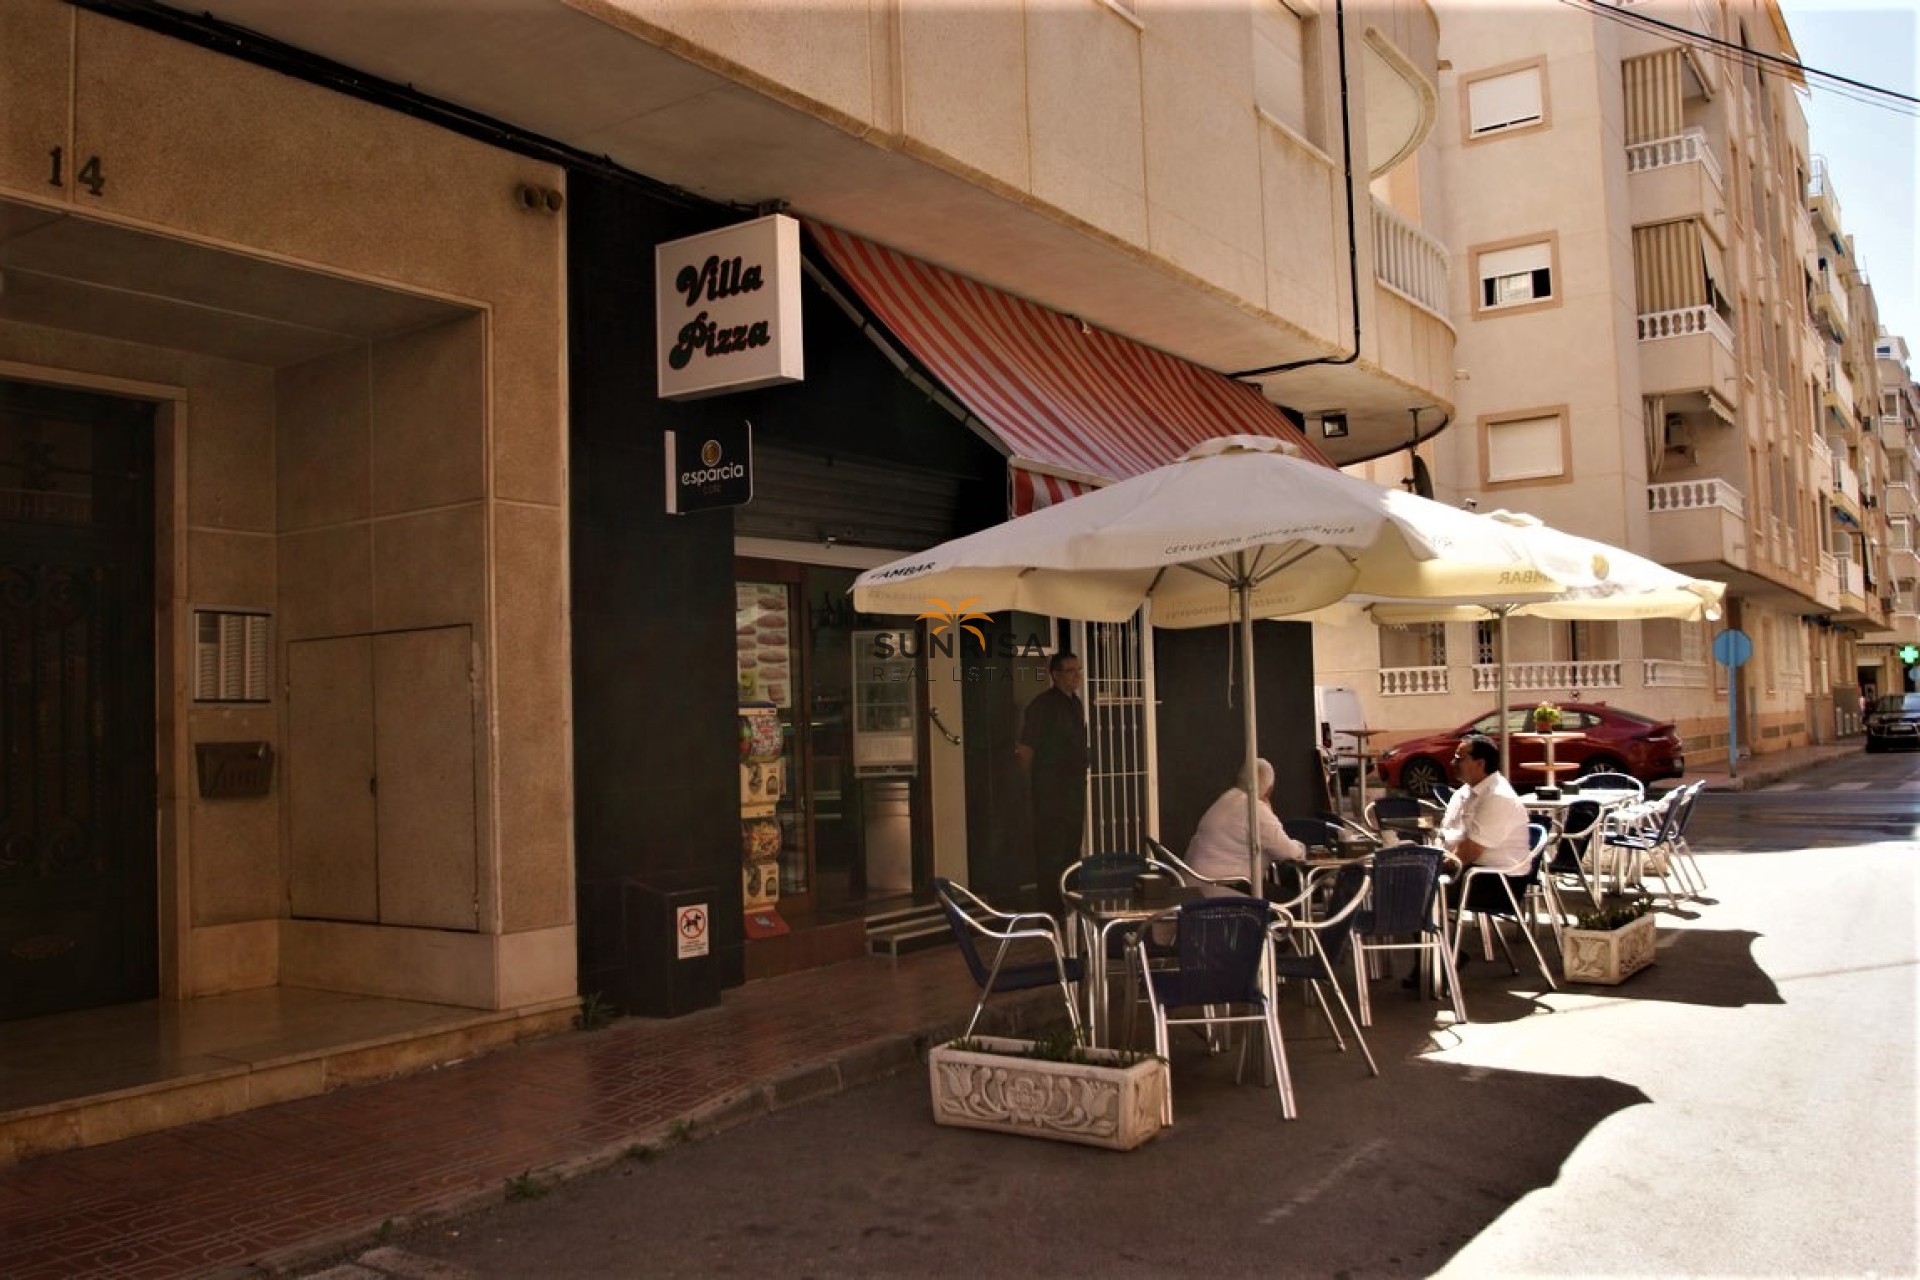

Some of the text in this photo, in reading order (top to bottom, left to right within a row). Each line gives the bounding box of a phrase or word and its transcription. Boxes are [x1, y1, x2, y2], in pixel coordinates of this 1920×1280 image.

[48, 146, 105, 197] 14
[676, 255, 763, 307] Villa
[669, 311, 771, 369] Pizza
[681, 462, 744, 486] esparcia
